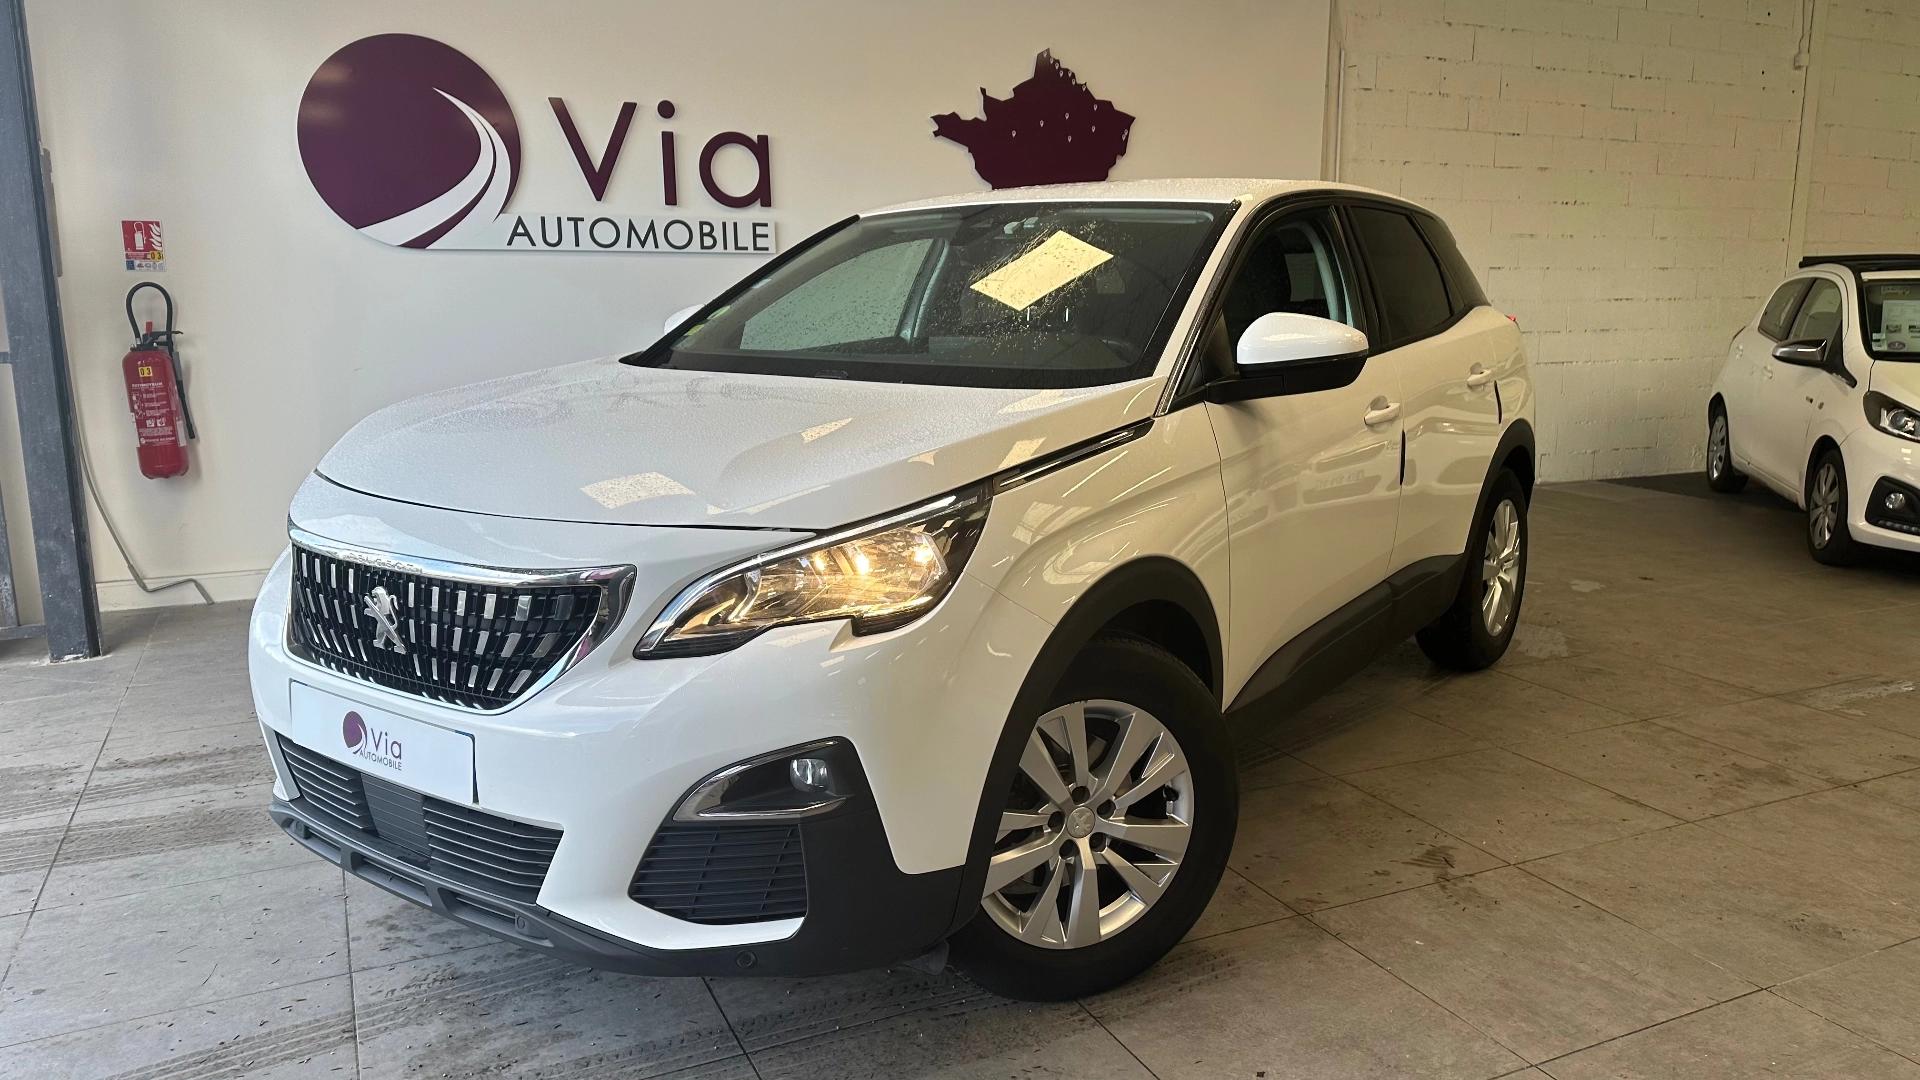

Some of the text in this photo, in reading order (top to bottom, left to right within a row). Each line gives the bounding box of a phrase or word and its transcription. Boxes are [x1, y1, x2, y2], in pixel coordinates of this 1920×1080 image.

[547, 97, 772, 208] Via
[506, 215, 770, 251] AUTOMOBILE
[359, 749, 403, 771] AUTOMOBILE
[370, 727, 402, 761] Via
